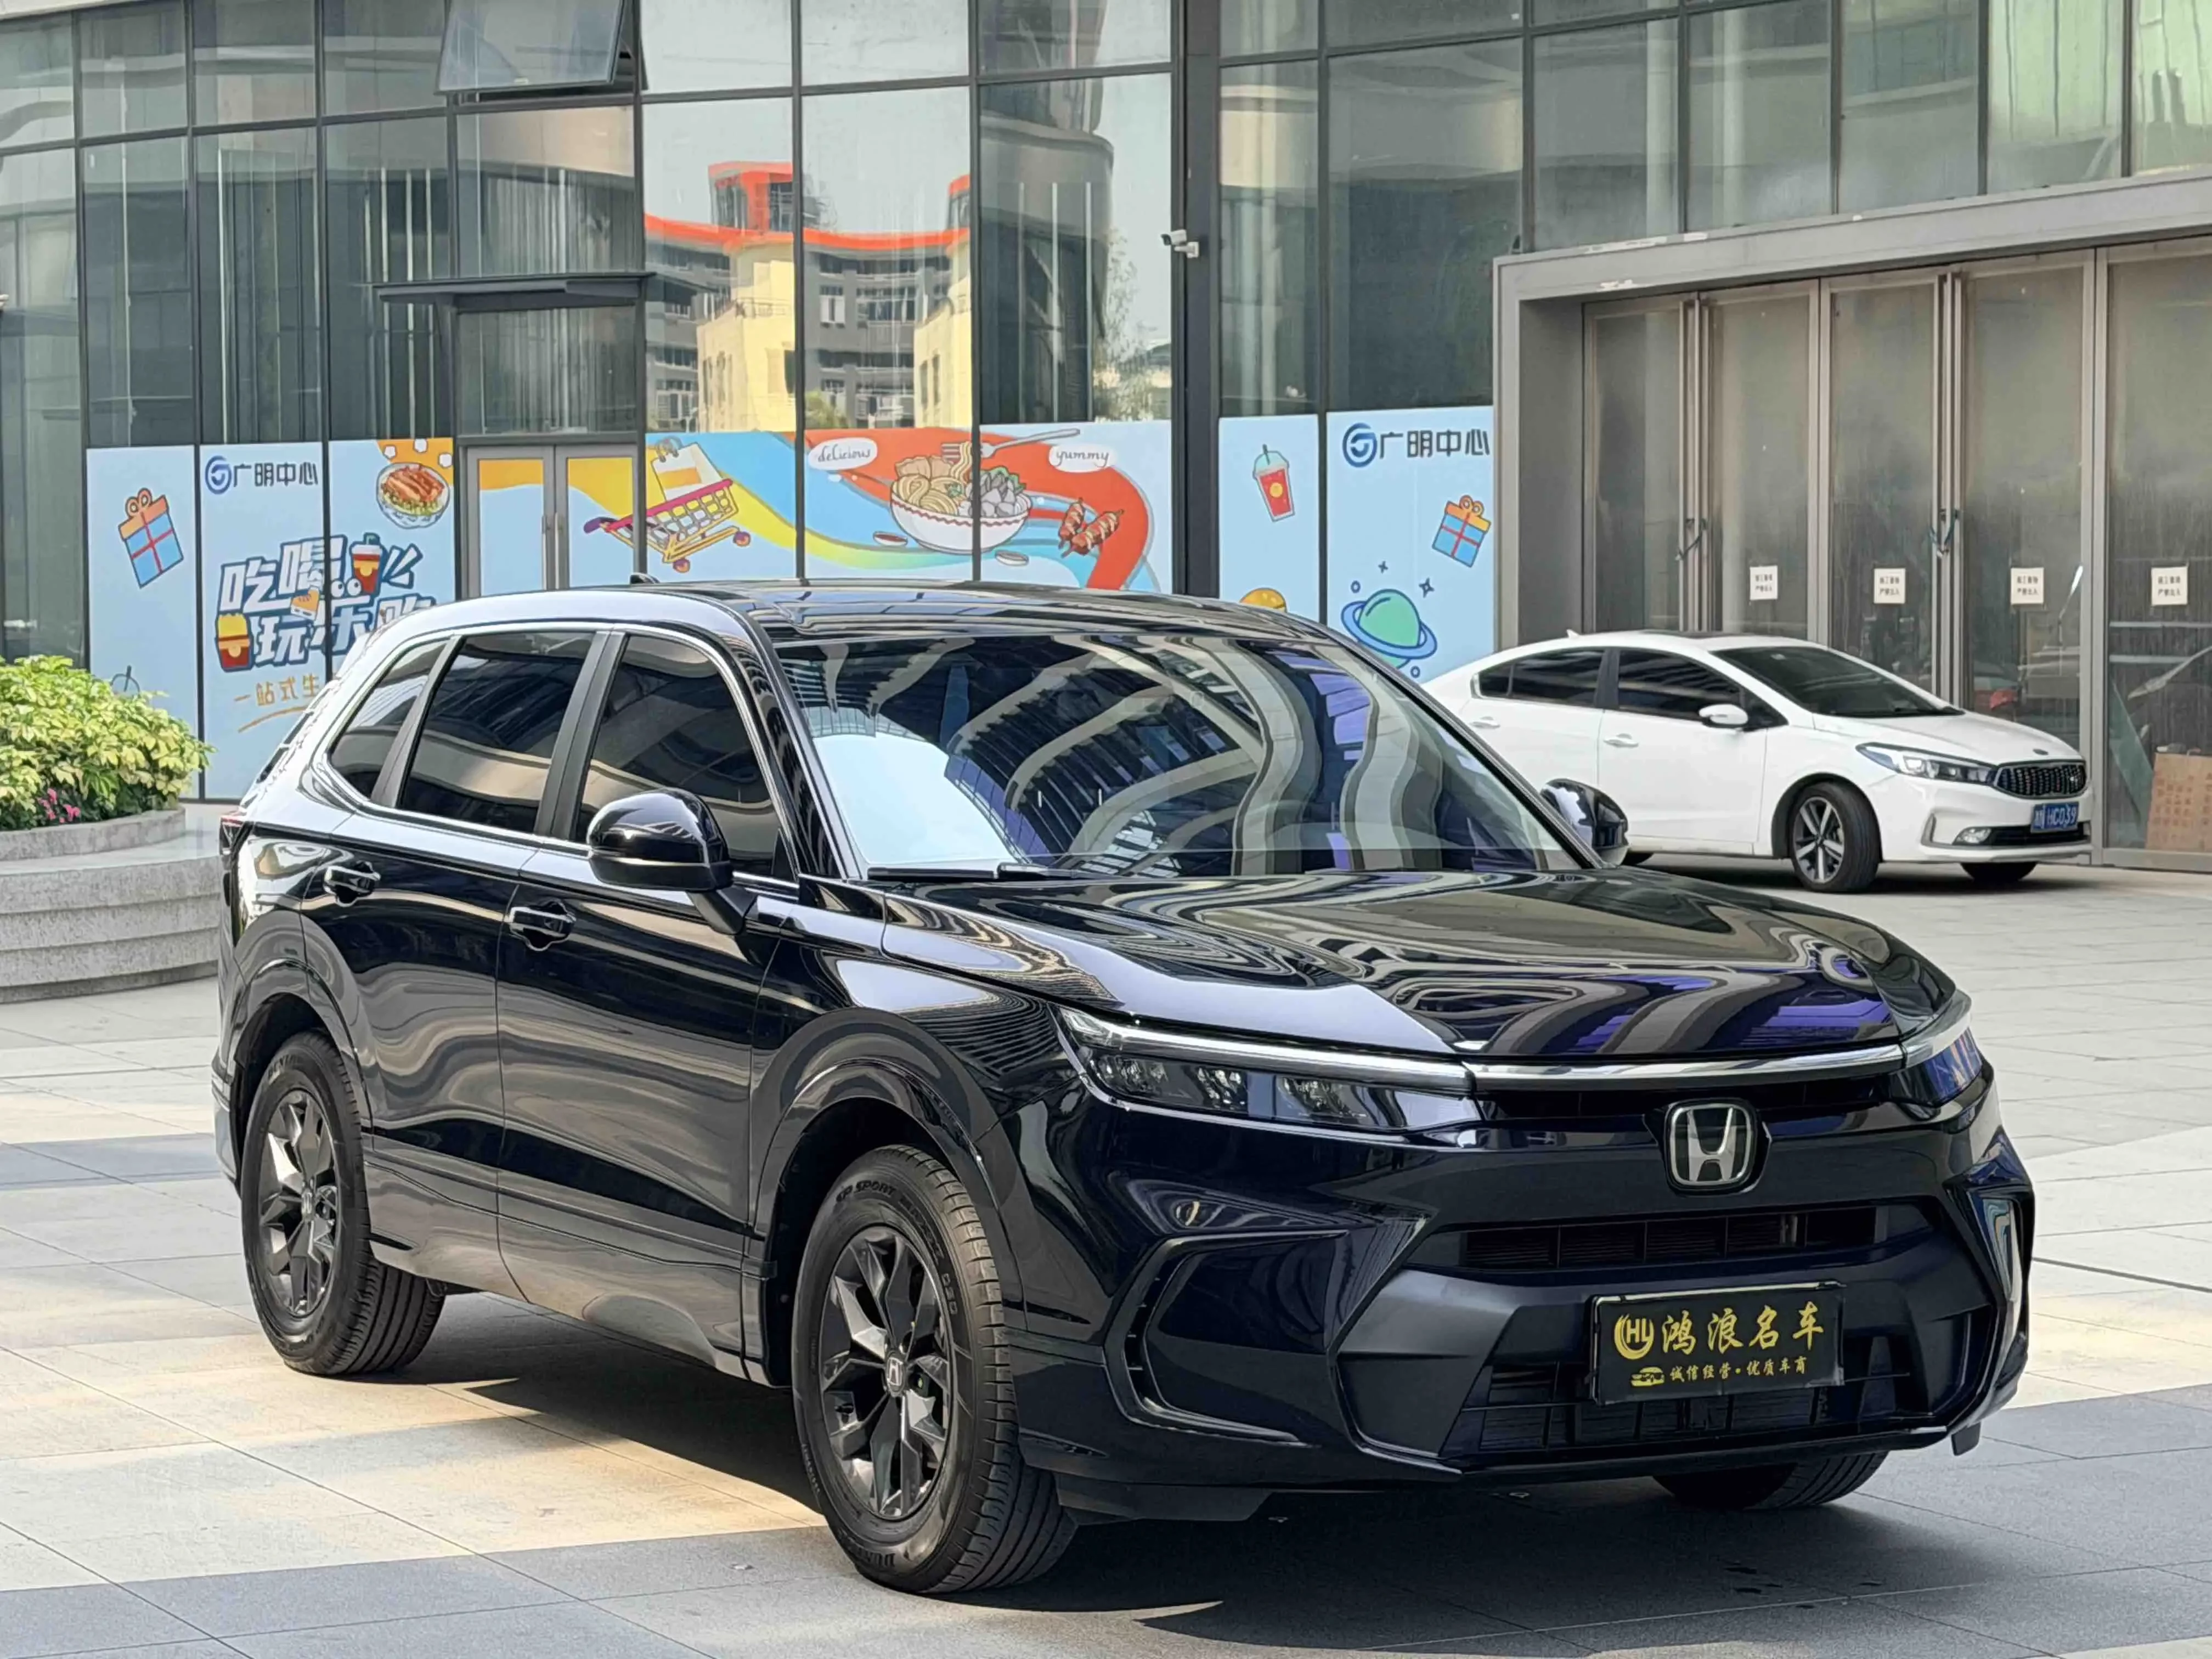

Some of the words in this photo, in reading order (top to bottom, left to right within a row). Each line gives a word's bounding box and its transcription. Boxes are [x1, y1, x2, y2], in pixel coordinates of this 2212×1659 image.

[817, 443, 871, 462] delicious
[1379, 428, 1491, 459] 广明中心
[1056, 450, 1109, 468] yummy
[233, 461, 318, 487] 广明中心
[854, 1180, 897, 1197] SPORT
[1662, 1301, 1824, 1355] 鸿浪名车
